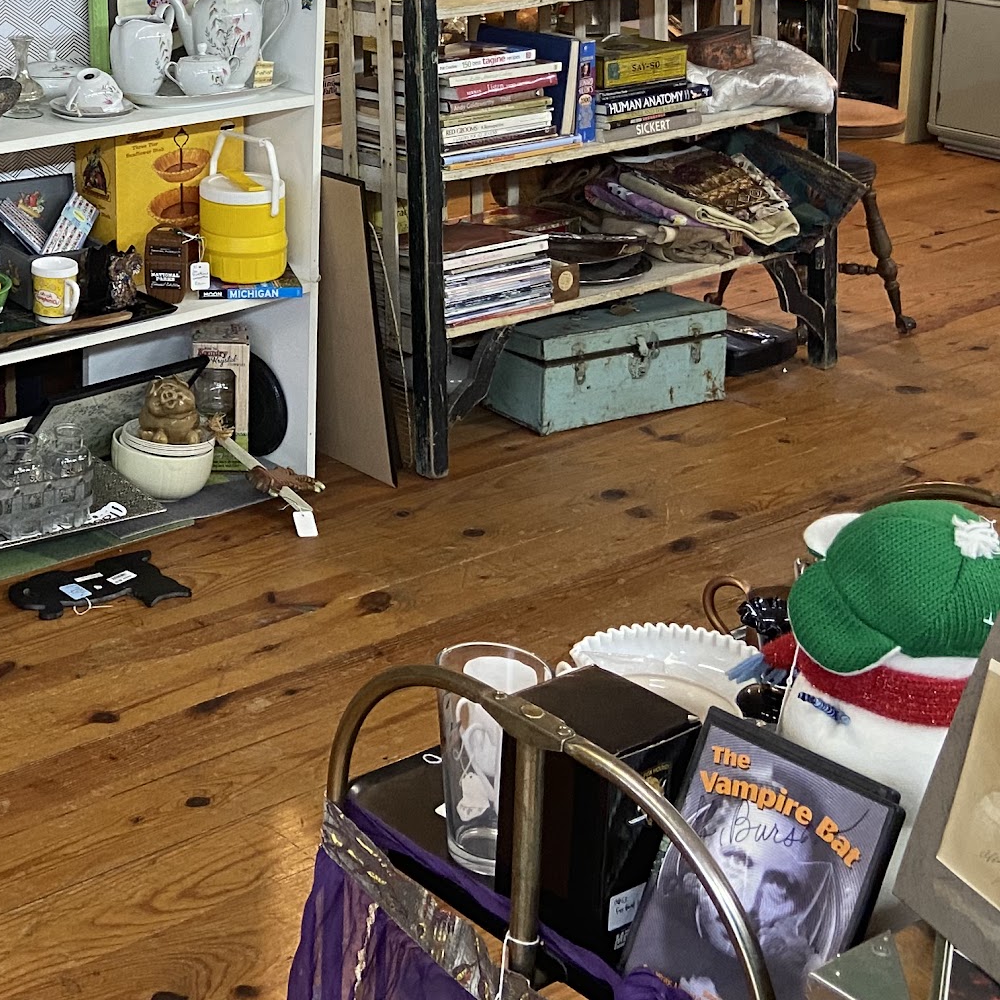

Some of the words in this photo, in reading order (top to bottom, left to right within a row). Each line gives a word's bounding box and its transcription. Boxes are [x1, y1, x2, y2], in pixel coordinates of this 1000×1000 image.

[482, 54, 506, 66] tagine
[631, 61, 660, 72] SAY-SO
[608, 98, 642, 115] HUMAN
[643, 91, 683, 108] ANATOMY
[636, 119, 671, 135] SICKERT
[229, 288, 279, 299] MICHIGAN
[711, 745, 751, 770] The
[700, 770, 813, 826] Vampire
[815, 815, 861, 869] Bat
